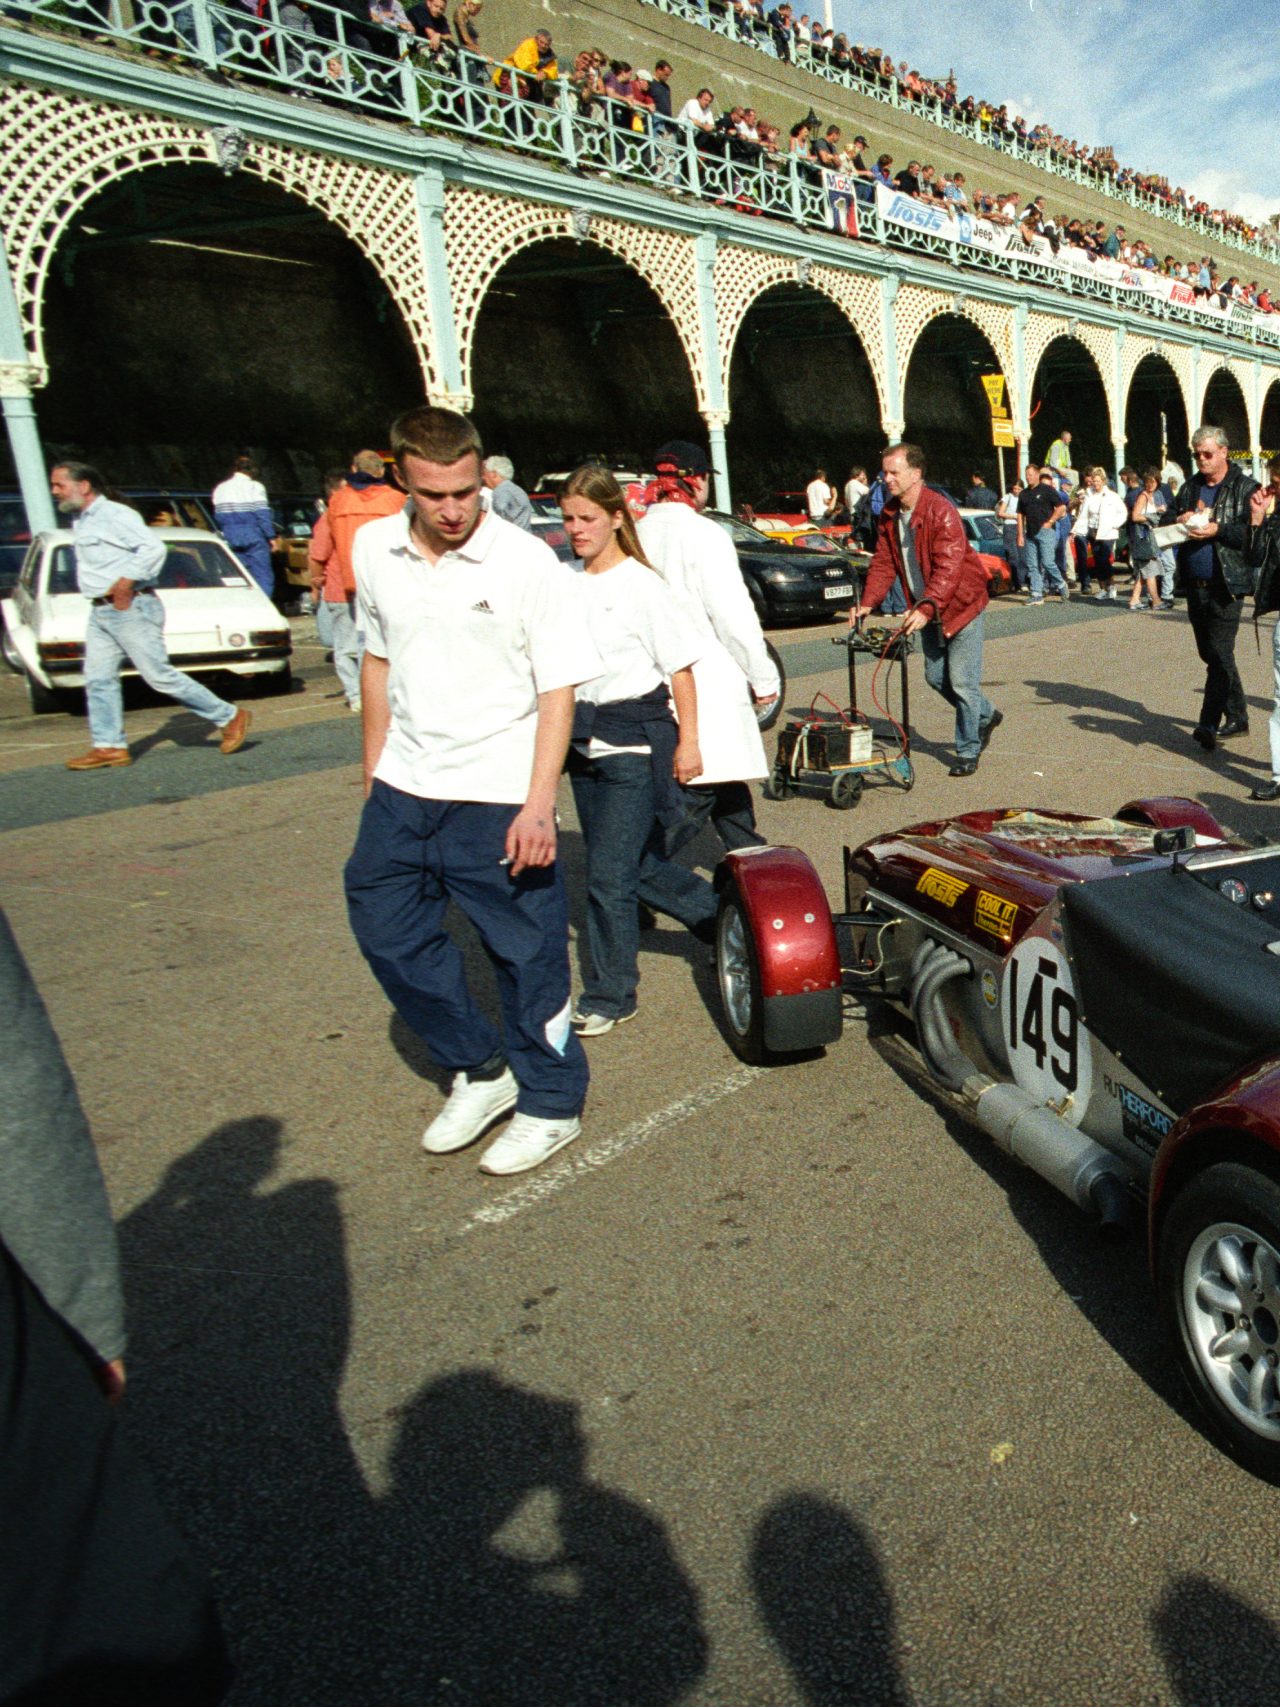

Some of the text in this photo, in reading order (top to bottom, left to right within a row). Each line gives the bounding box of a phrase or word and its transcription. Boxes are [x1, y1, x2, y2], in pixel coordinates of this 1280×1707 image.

[887, 195, 948, 232] Frosts
[973, 223, 994, 242] Jeep
[916, 867, 970, 908] Frosts
[978, 894, 1014, 920] COOL IT
[1009, 956, 1078, 1093] 149
